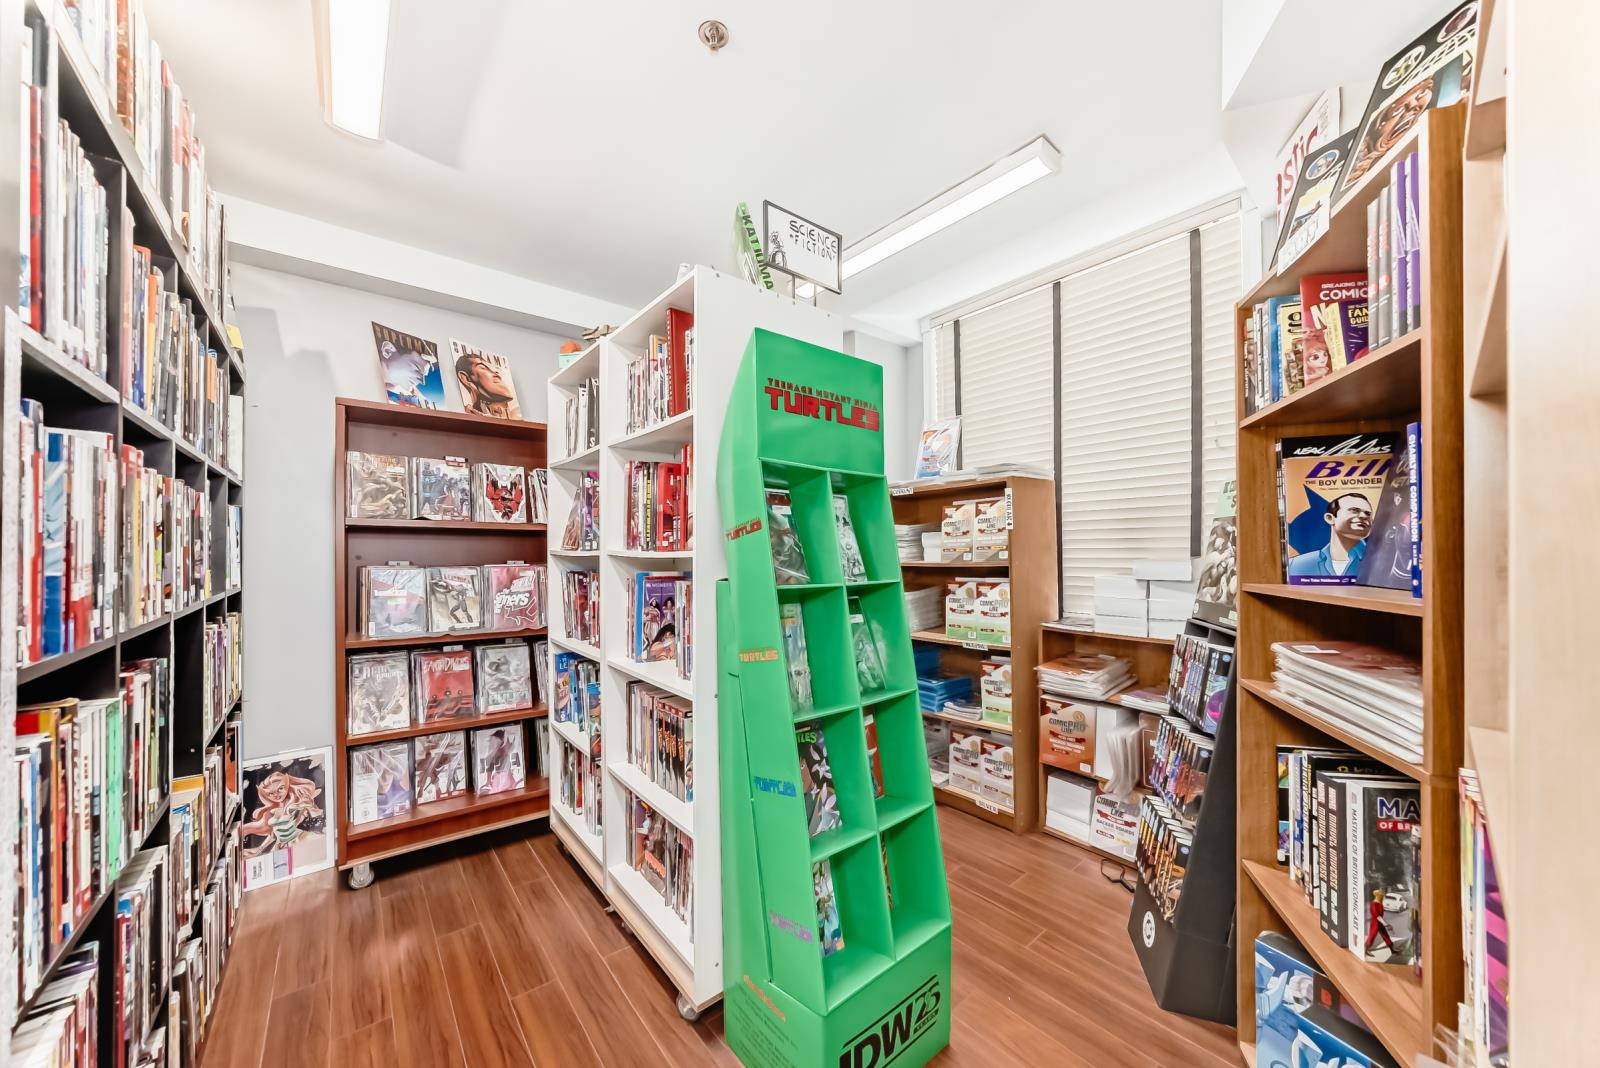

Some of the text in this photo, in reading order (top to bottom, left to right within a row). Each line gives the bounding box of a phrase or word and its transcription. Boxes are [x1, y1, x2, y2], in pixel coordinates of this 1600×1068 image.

[789, 219, 838, 254] SCIENCE
[1321, 281, 1356, 289] BREAKING
[452, 341, 508, 369] SHAZAM!
[764, 386, 880, 432] TURTLES
[767, 377, 877, 412] TEENAGE MUTANT NINJA
[1305, 459, 1393, 479] Bill
[1408, 434, 1417, 484] CHARLTON
[1318, 479, 1338, 487] BOY
[1341, 478, 1383, 486] WONDER
[1409, 485, 1419, 542] COMPANION
[1318, 806, 1327, 840] MARVEL
[1376, 797, 1420, 820] MA
[1378, 821, 1394, 830] OF
[1328, 812, 1338, 848] MARVEL
[1319, 839, 1328, 881] UNIVERSE
[1352, 843, 1358, 856] OF
[1329, 848, 1339, 891] UNIVERSE
